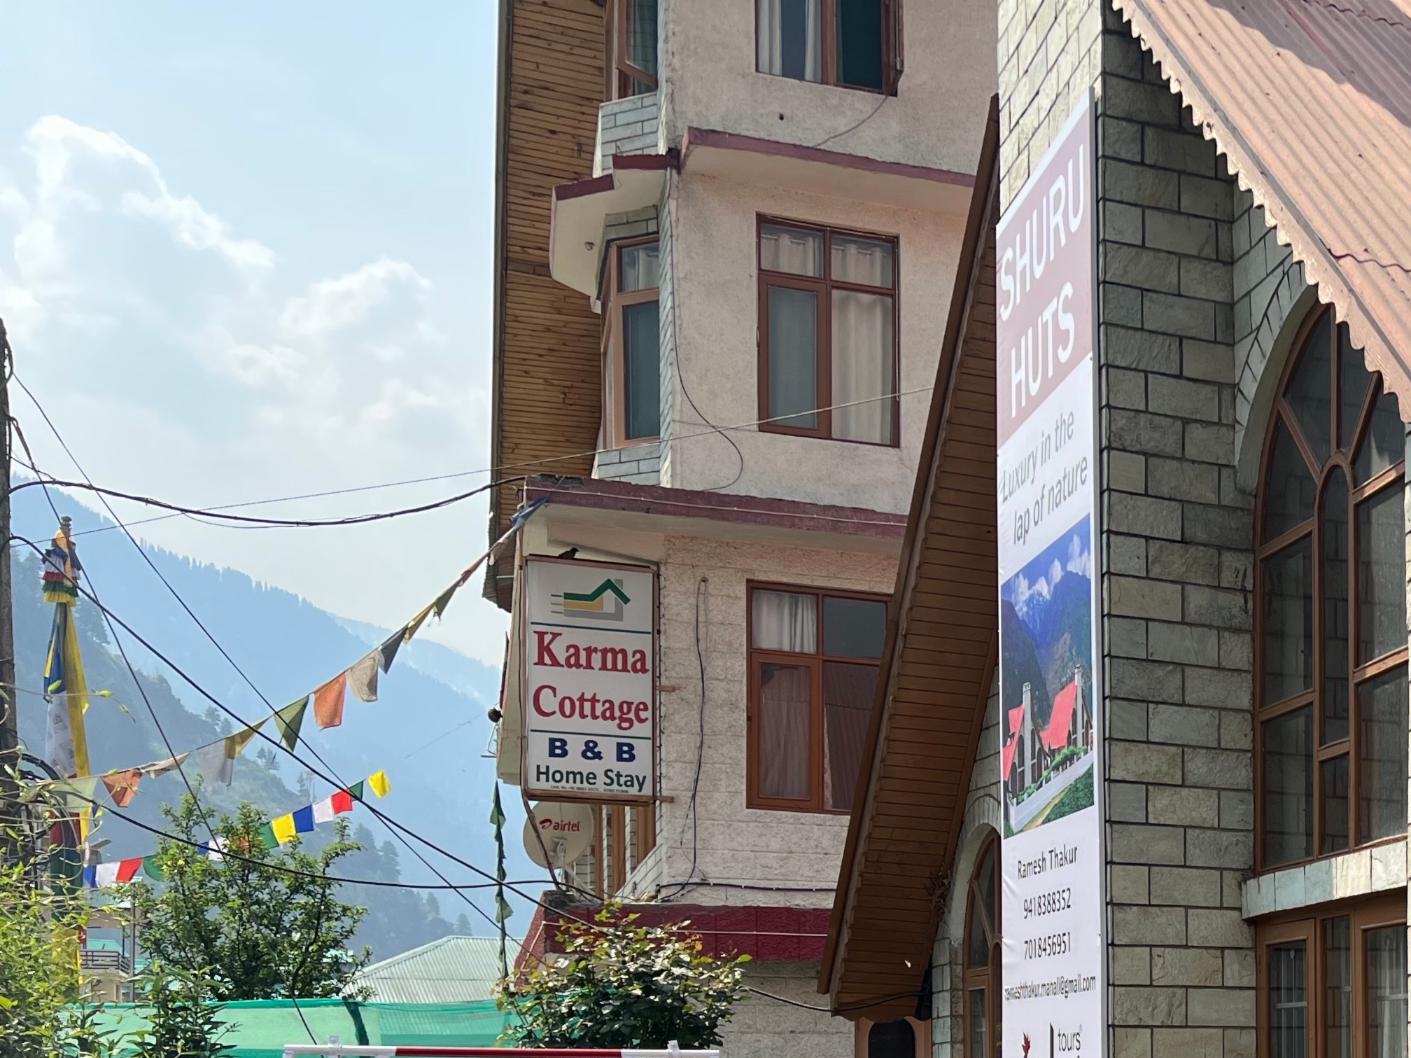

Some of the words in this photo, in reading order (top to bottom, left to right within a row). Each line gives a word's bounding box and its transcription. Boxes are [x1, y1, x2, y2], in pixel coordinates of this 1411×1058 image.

[1000, 144, 1086, 321] SHURU
[1010, 282, 1076, 418] HUTS
[1001, 445, 1039, 503] Luxury
[1041, 429, 1051, 466] in
[1054, 410, 1075, 453] the
[1013, 506, 1030, 545] lap
[1033, 484, 1046, 527] of
[1047, 456, 1088, 515] nature
[533, 630, 650, 674] Karma
[532, 684, 650, 731] Cottage
[548, 737, 569, 758] B
[581, 739, 604, 761] &
[616, 741, 637, 763] B
[535, 764, 598, 786] Home
[603, 768, 647, 793] Stay
[552, 820, 581, 833] airtel
[1017, 850, 1047, 880] Ramesh
[1048, 843, 1078, 870] Thakur
[1023, 887, 1072, 919] 9418388352
[1024, 931, 1071, 960] 7018456951
[1057, 1030, 1082, 1052] tours
